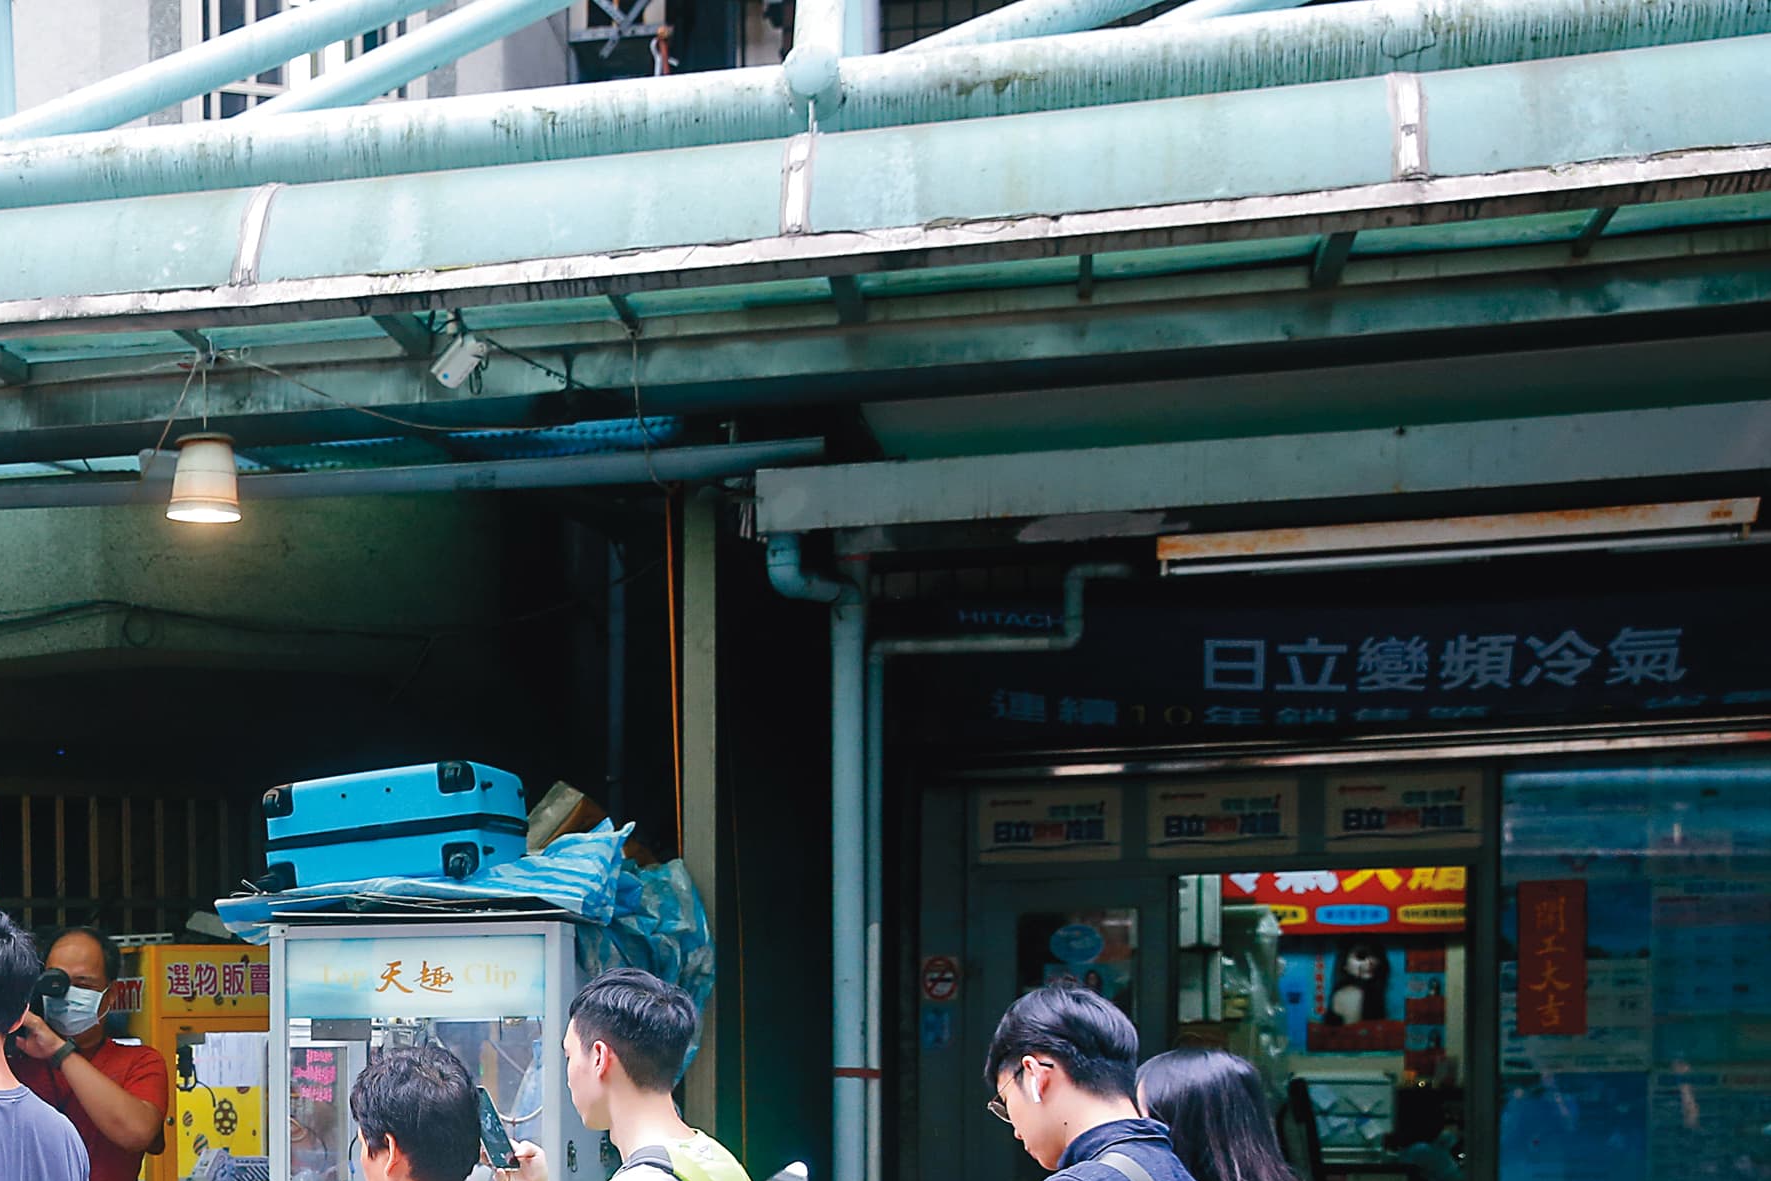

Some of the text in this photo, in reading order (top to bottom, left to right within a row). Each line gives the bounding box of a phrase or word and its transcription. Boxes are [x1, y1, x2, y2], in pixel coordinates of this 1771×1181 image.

[1203, 626, 1687, 693] 日立變頻冷氣
[166, 963, 269, 996] 選物販賣
[375, 960, 455, 994] 天趣
